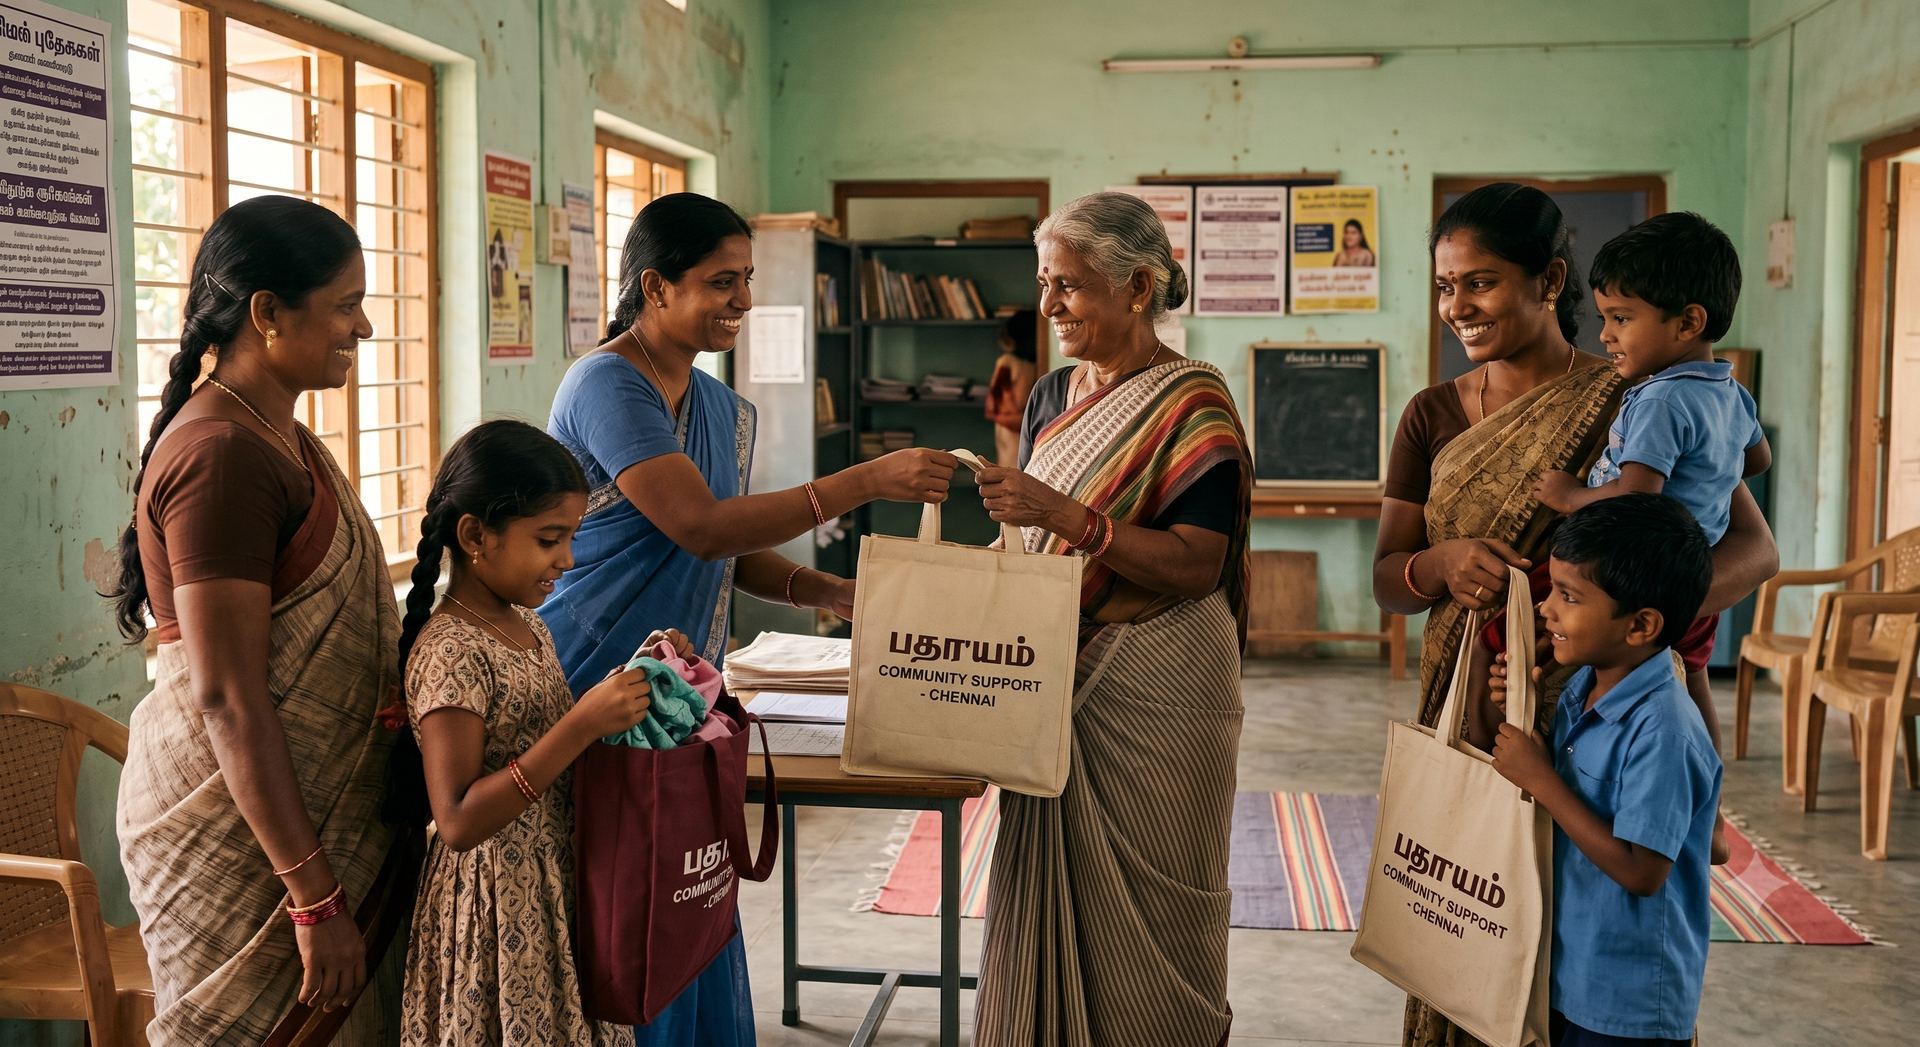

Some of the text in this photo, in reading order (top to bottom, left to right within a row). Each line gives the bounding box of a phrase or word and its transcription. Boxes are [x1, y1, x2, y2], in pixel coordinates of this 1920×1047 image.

[889, 631, 1035, 667] பதாயம்
[878, 664, 1042, 693] COMMUNITY SUPPORT
[929, 688, 996, 707] CHENNAI
[1393, 832, 1506, 909] பதாயம்
[1383, 863, 1508, 939] COMMUNITY SUPPORT
[1413, 901, 1465, 939] CHENNAI
